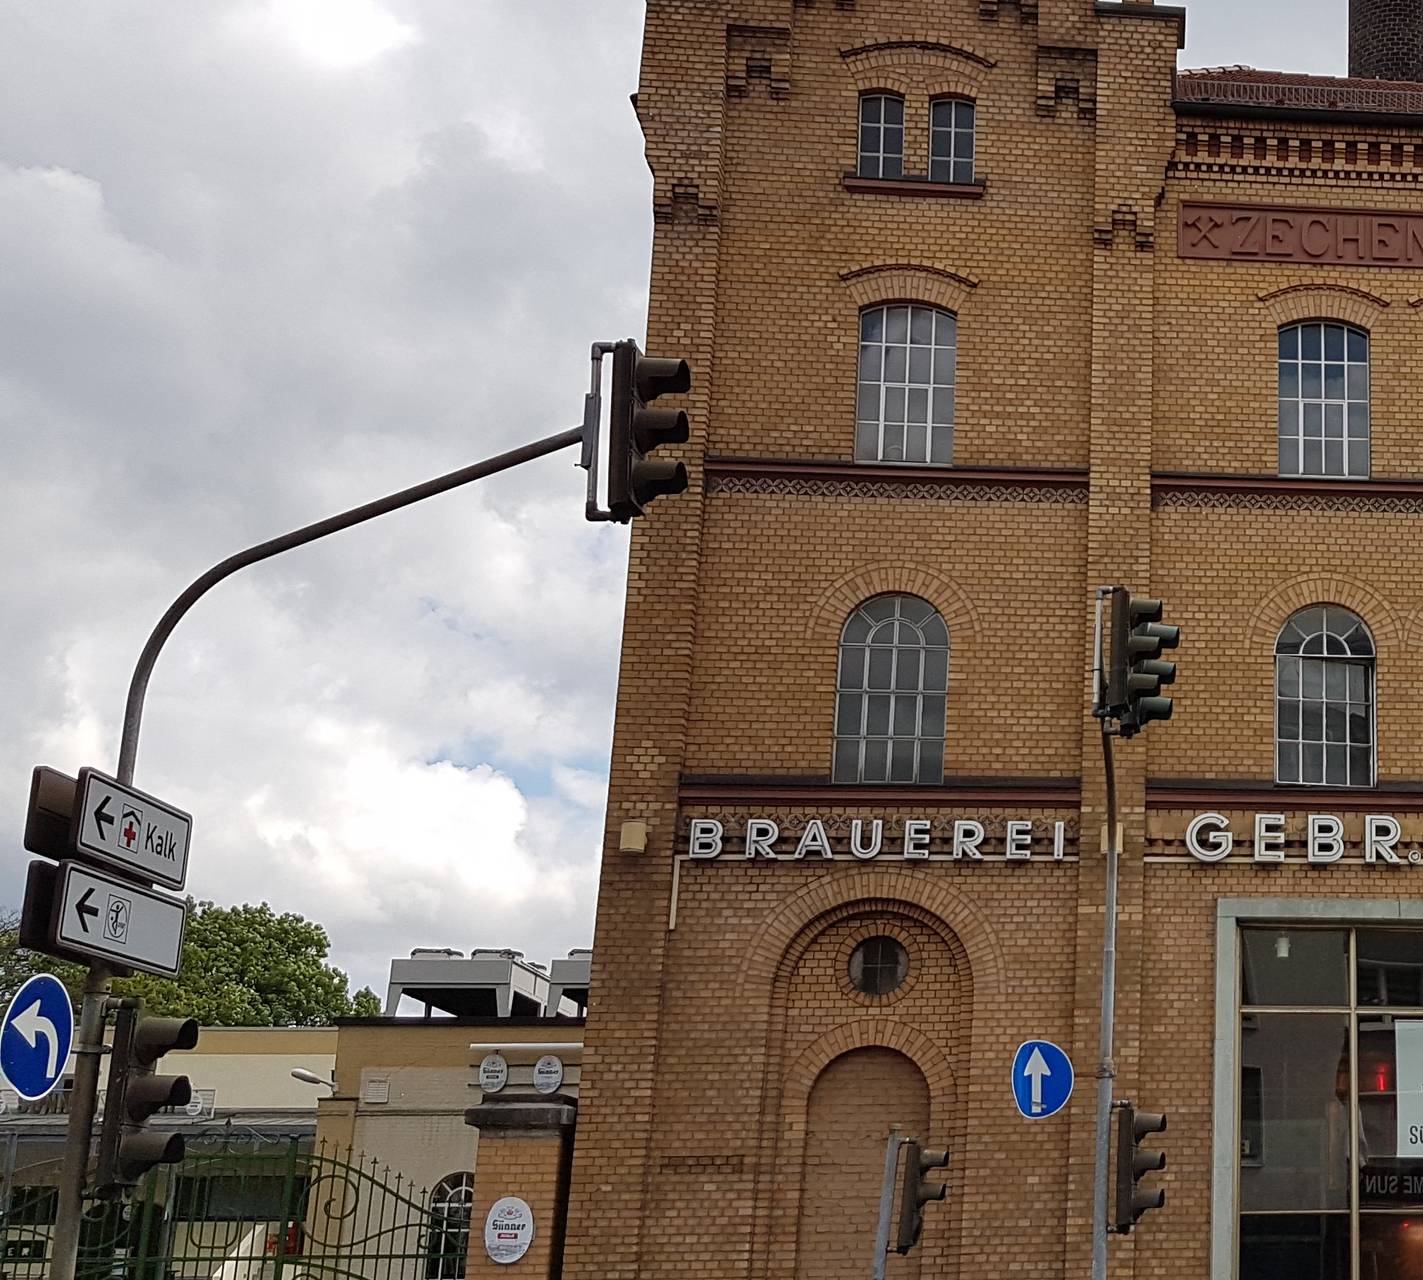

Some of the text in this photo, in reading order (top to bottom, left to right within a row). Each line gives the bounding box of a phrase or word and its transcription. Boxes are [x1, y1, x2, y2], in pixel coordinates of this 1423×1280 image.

[144, 821, 178, 862] Kalk
[688, 818, 1065, 862] BRAUEREI
[1184, 811, 1422, 865] GEBR.
